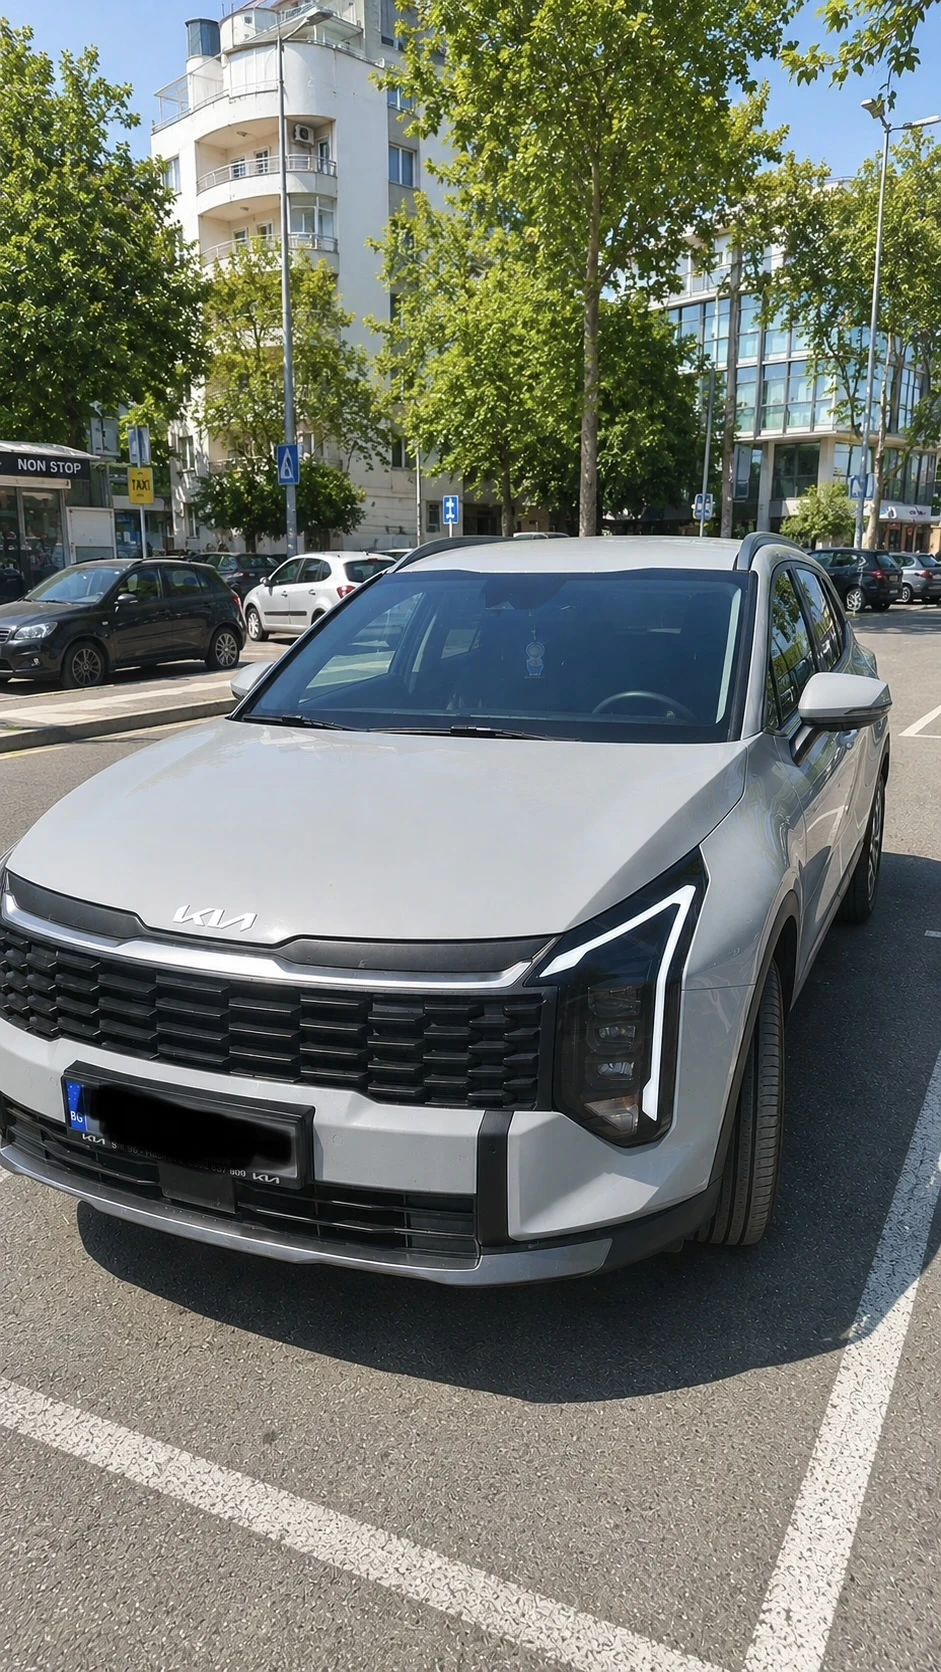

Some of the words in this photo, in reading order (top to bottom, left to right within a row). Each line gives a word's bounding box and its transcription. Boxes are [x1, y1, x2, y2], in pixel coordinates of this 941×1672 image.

[17, 458, 47, 472] NON
[50, 461, 82, 474] STOP
[131, 479, 151, 491] TAXI
[172, 904, 258, 932] KIA
[70, 1110, 83, 1123] BG
[82, 1133, 106, 1145] KIA
[252, 1172, 280, 1184] KIA
